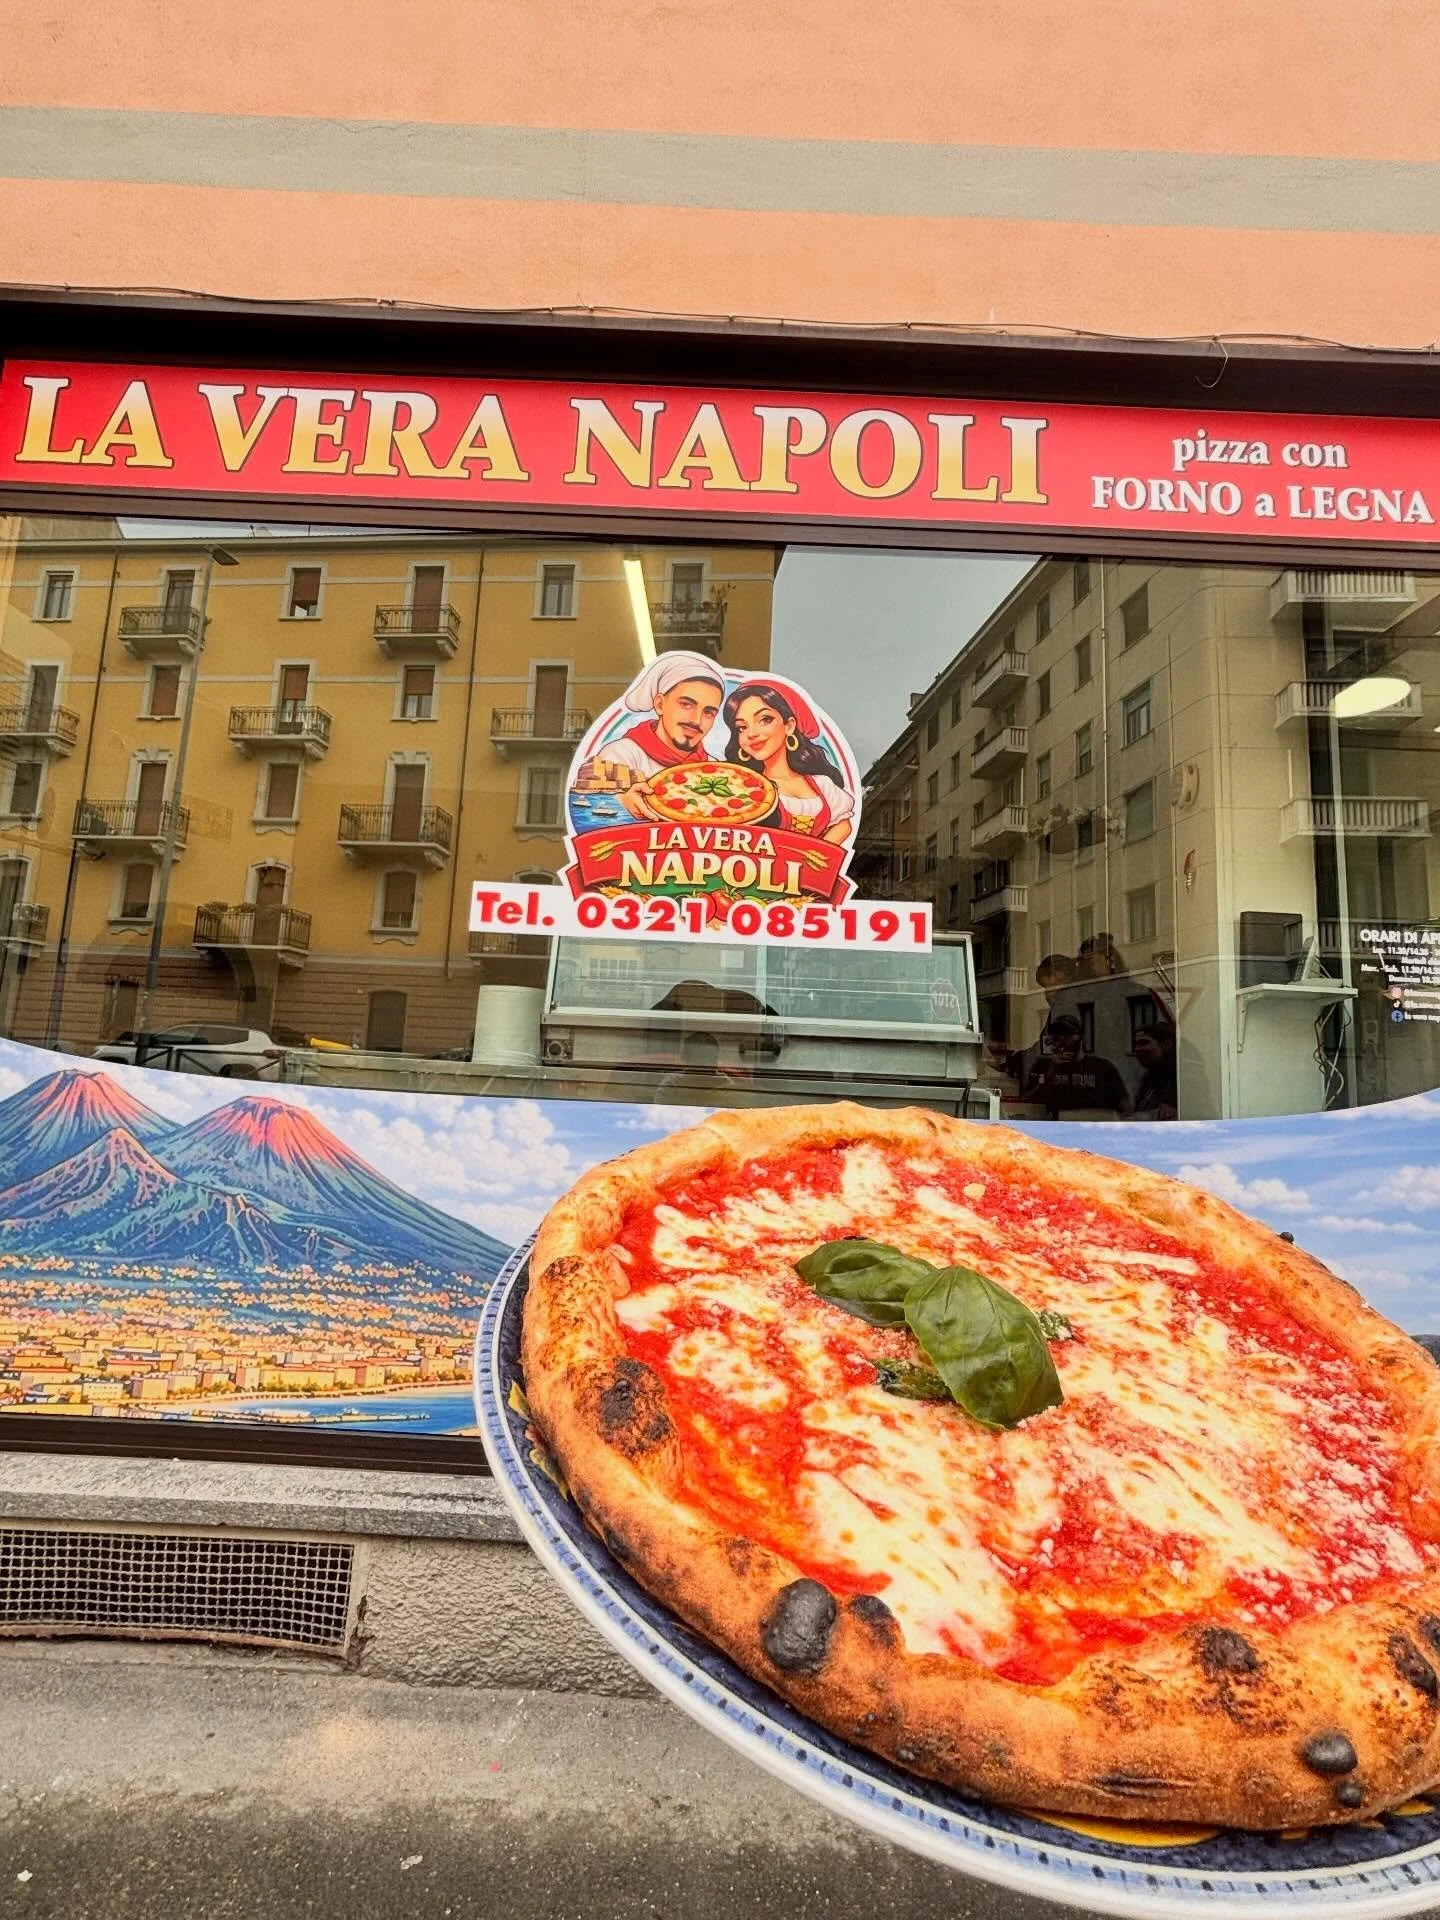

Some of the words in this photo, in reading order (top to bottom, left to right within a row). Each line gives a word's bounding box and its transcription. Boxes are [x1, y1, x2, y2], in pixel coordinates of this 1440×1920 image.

[15, 376, 175, 469] LA
[198, 383, 530, 481] VERA
[563, 397, 1049, 504] NAPOLI
[1172, 428, 1270, 471] pizza
[1281, 441, 1348, 469] con
[1091, 475, 1242, 517] FORNO
[1254, 492, 1277, 518] a
[1287, 484, 1435, 524] LEGNA
[648, 826, 688, 850] LA
[690, 826, 777, 857] VERA
[619, 851, 804, 896] NAPOLI
[476, 890, 556, 927] Tel.
[577, 897, 708, 934] 0321
[731, 904, 928, 944] 085191
[1360, 929, 1401, 943] ORARI
[1404, 931, 1418, 944] DI
